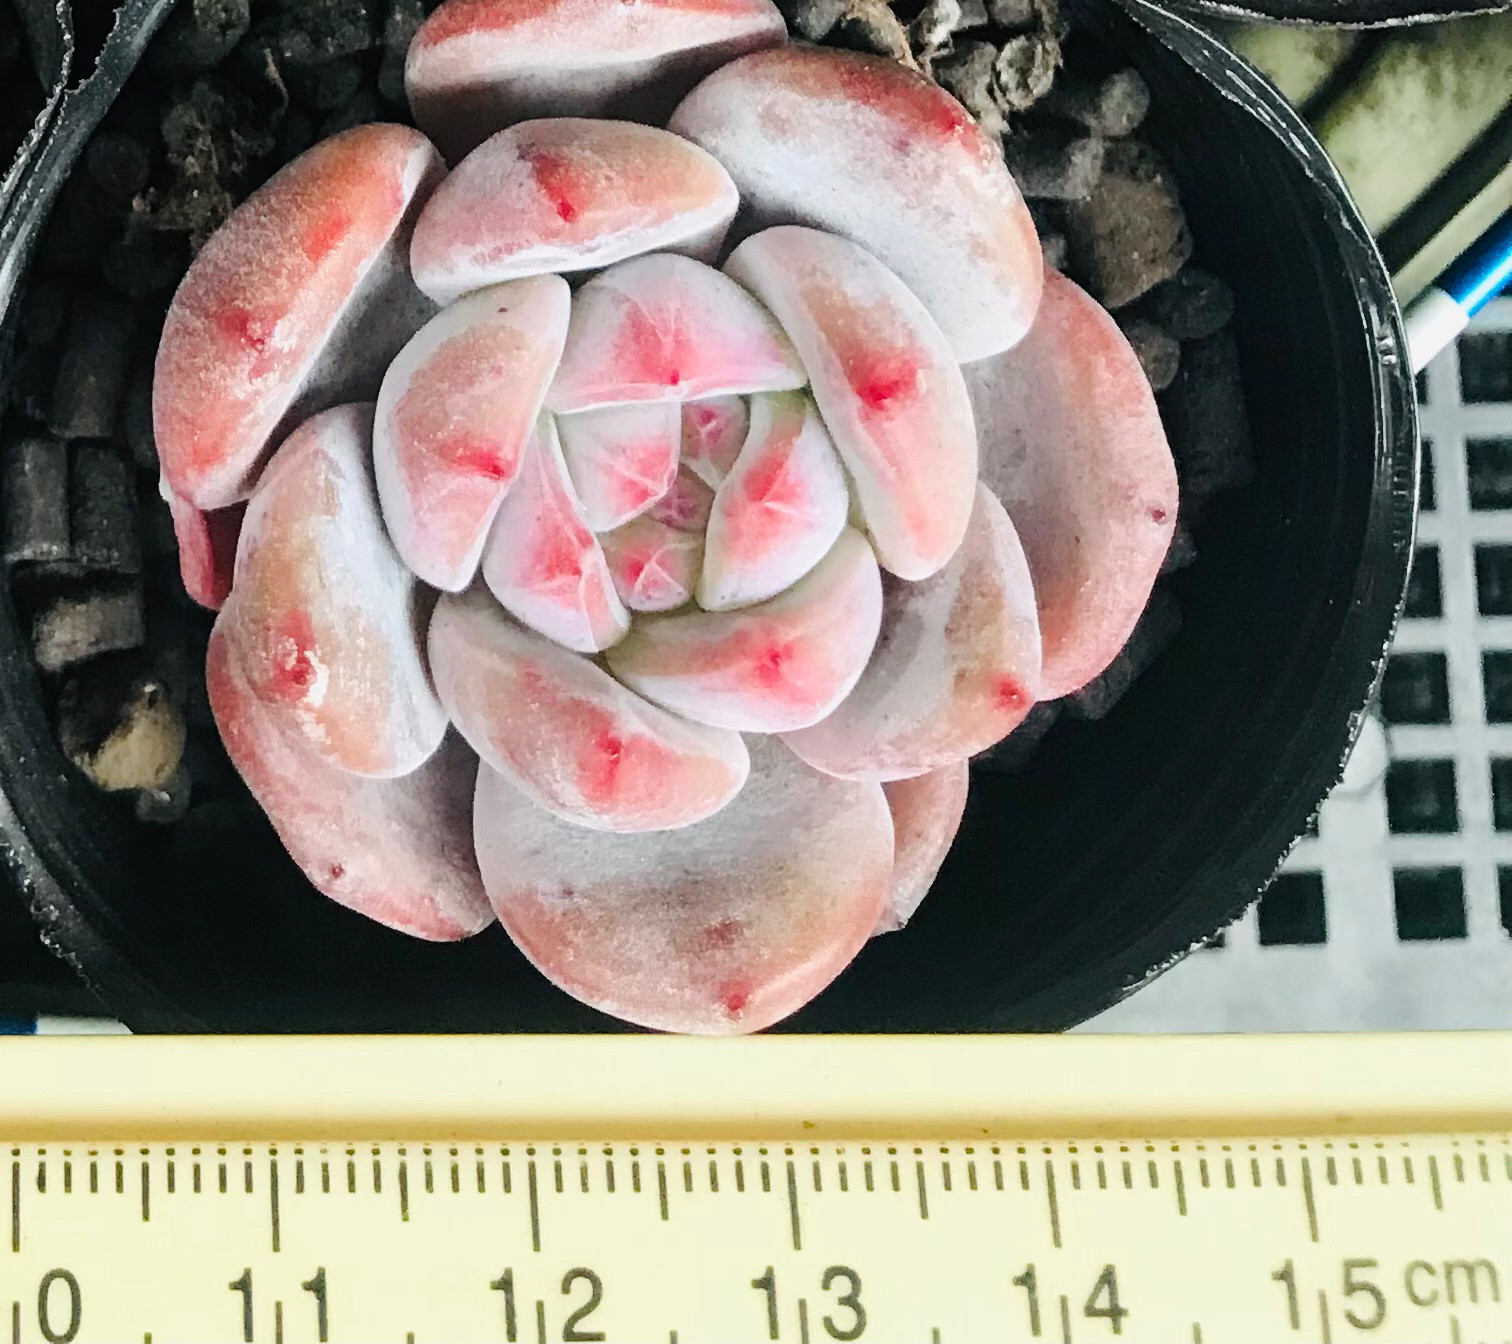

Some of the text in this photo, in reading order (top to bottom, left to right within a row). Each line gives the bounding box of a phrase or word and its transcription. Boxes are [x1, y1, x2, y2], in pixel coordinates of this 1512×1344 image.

[228, 1267, 328, 1343] 11
[490, 1268, 605, 1343] 12
[751, 1267, 868, 1342] 13
[1013, 1266, 1128, 1336] 14
[1271, 1258, 1386, 1330] 15
[1403, 1258, 1501, 1307] cm
